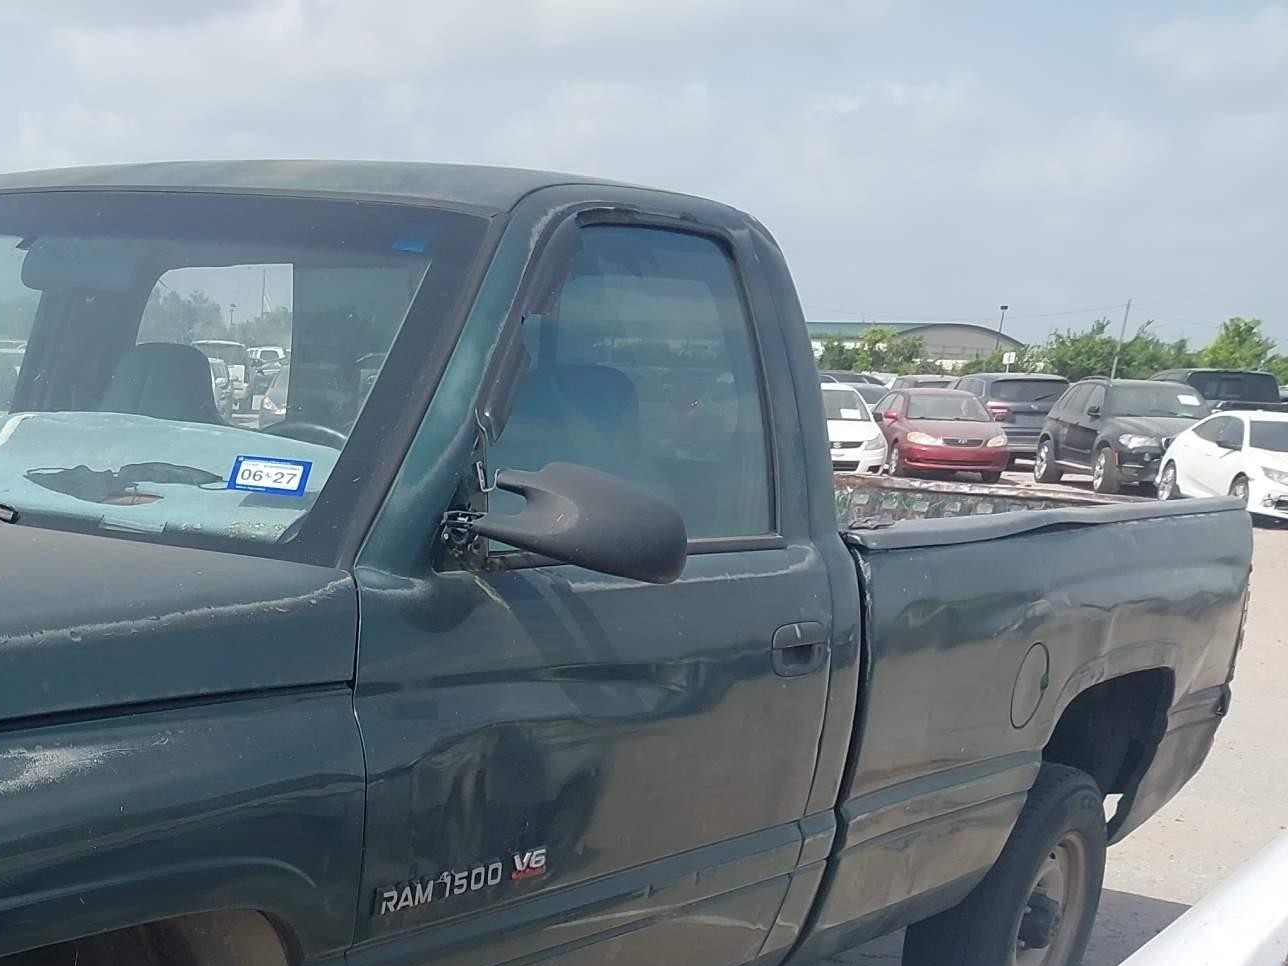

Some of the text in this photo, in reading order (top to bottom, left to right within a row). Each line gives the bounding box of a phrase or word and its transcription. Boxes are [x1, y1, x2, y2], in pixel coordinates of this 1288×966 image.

[381, 848, 547, 915] RAM 1500 V6
